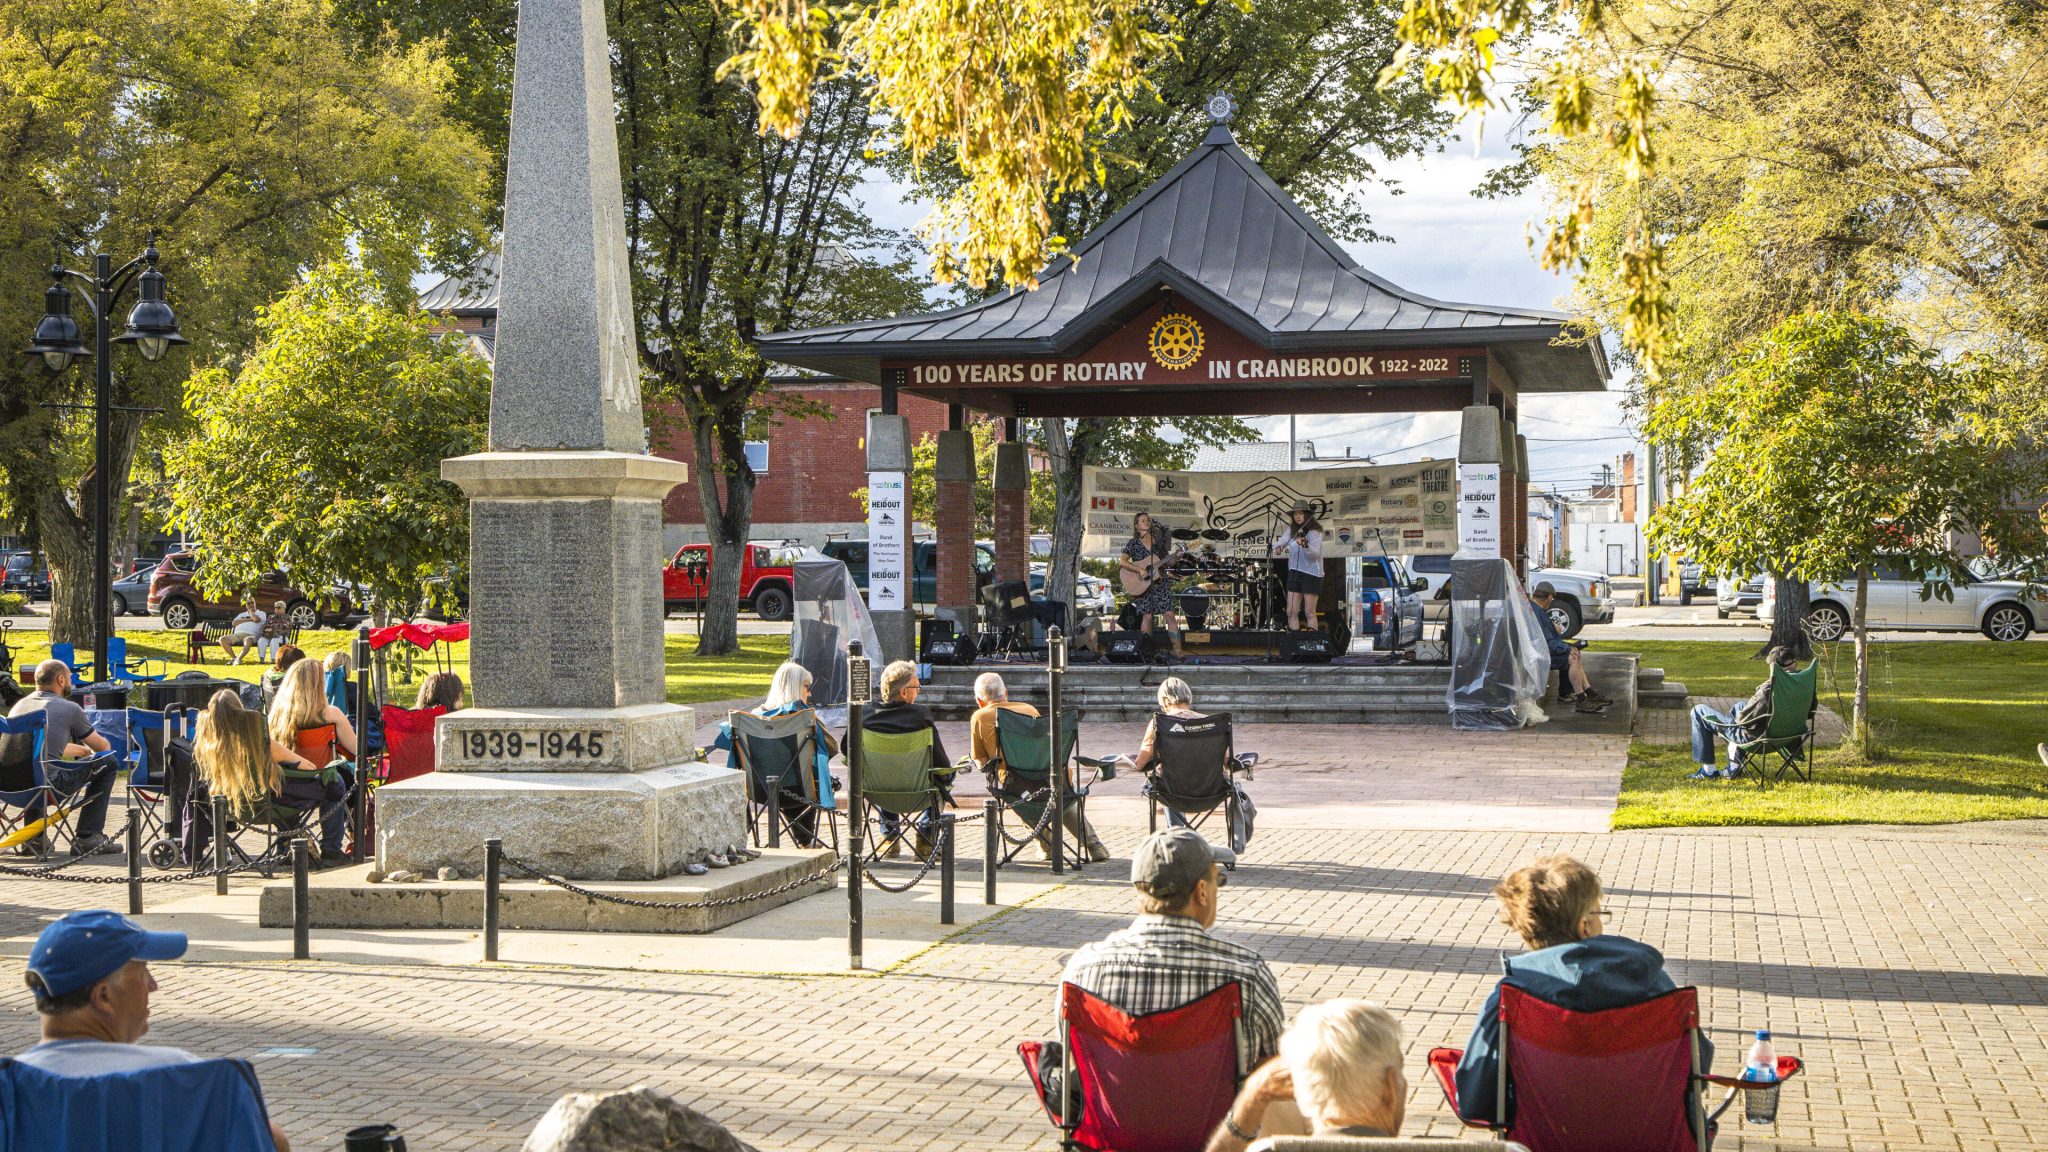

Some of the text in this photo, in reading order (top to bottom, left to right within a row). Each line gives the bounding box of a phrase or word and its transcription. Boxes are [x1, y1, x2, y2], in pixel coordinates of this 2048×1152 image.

[1157, 349, 1197, 365] INTERNATIONAL
[912, 362, 1147, 383] 100 YEARS OF ROTARY
[1208, 360, 1231, 378] IN
[1237, 357, 1374, 378] CRANBROOK
[1380, 359, 1409, 373] 1922
[1419, 358, 1449, 371] 2022
[1422, 469, 1448, 480] KEY CITY
[1158, 476, 1174, 492] pb
[1422, 481, 1448, 493] THEATRE
[1089, 521, 1132, 530] CRANBROOK
[1378, 516, 1418, 524] Scotiabank
[871, 571, 900, 579] HEIDOUT
[462, 731, 603, 758] 1939-1945
